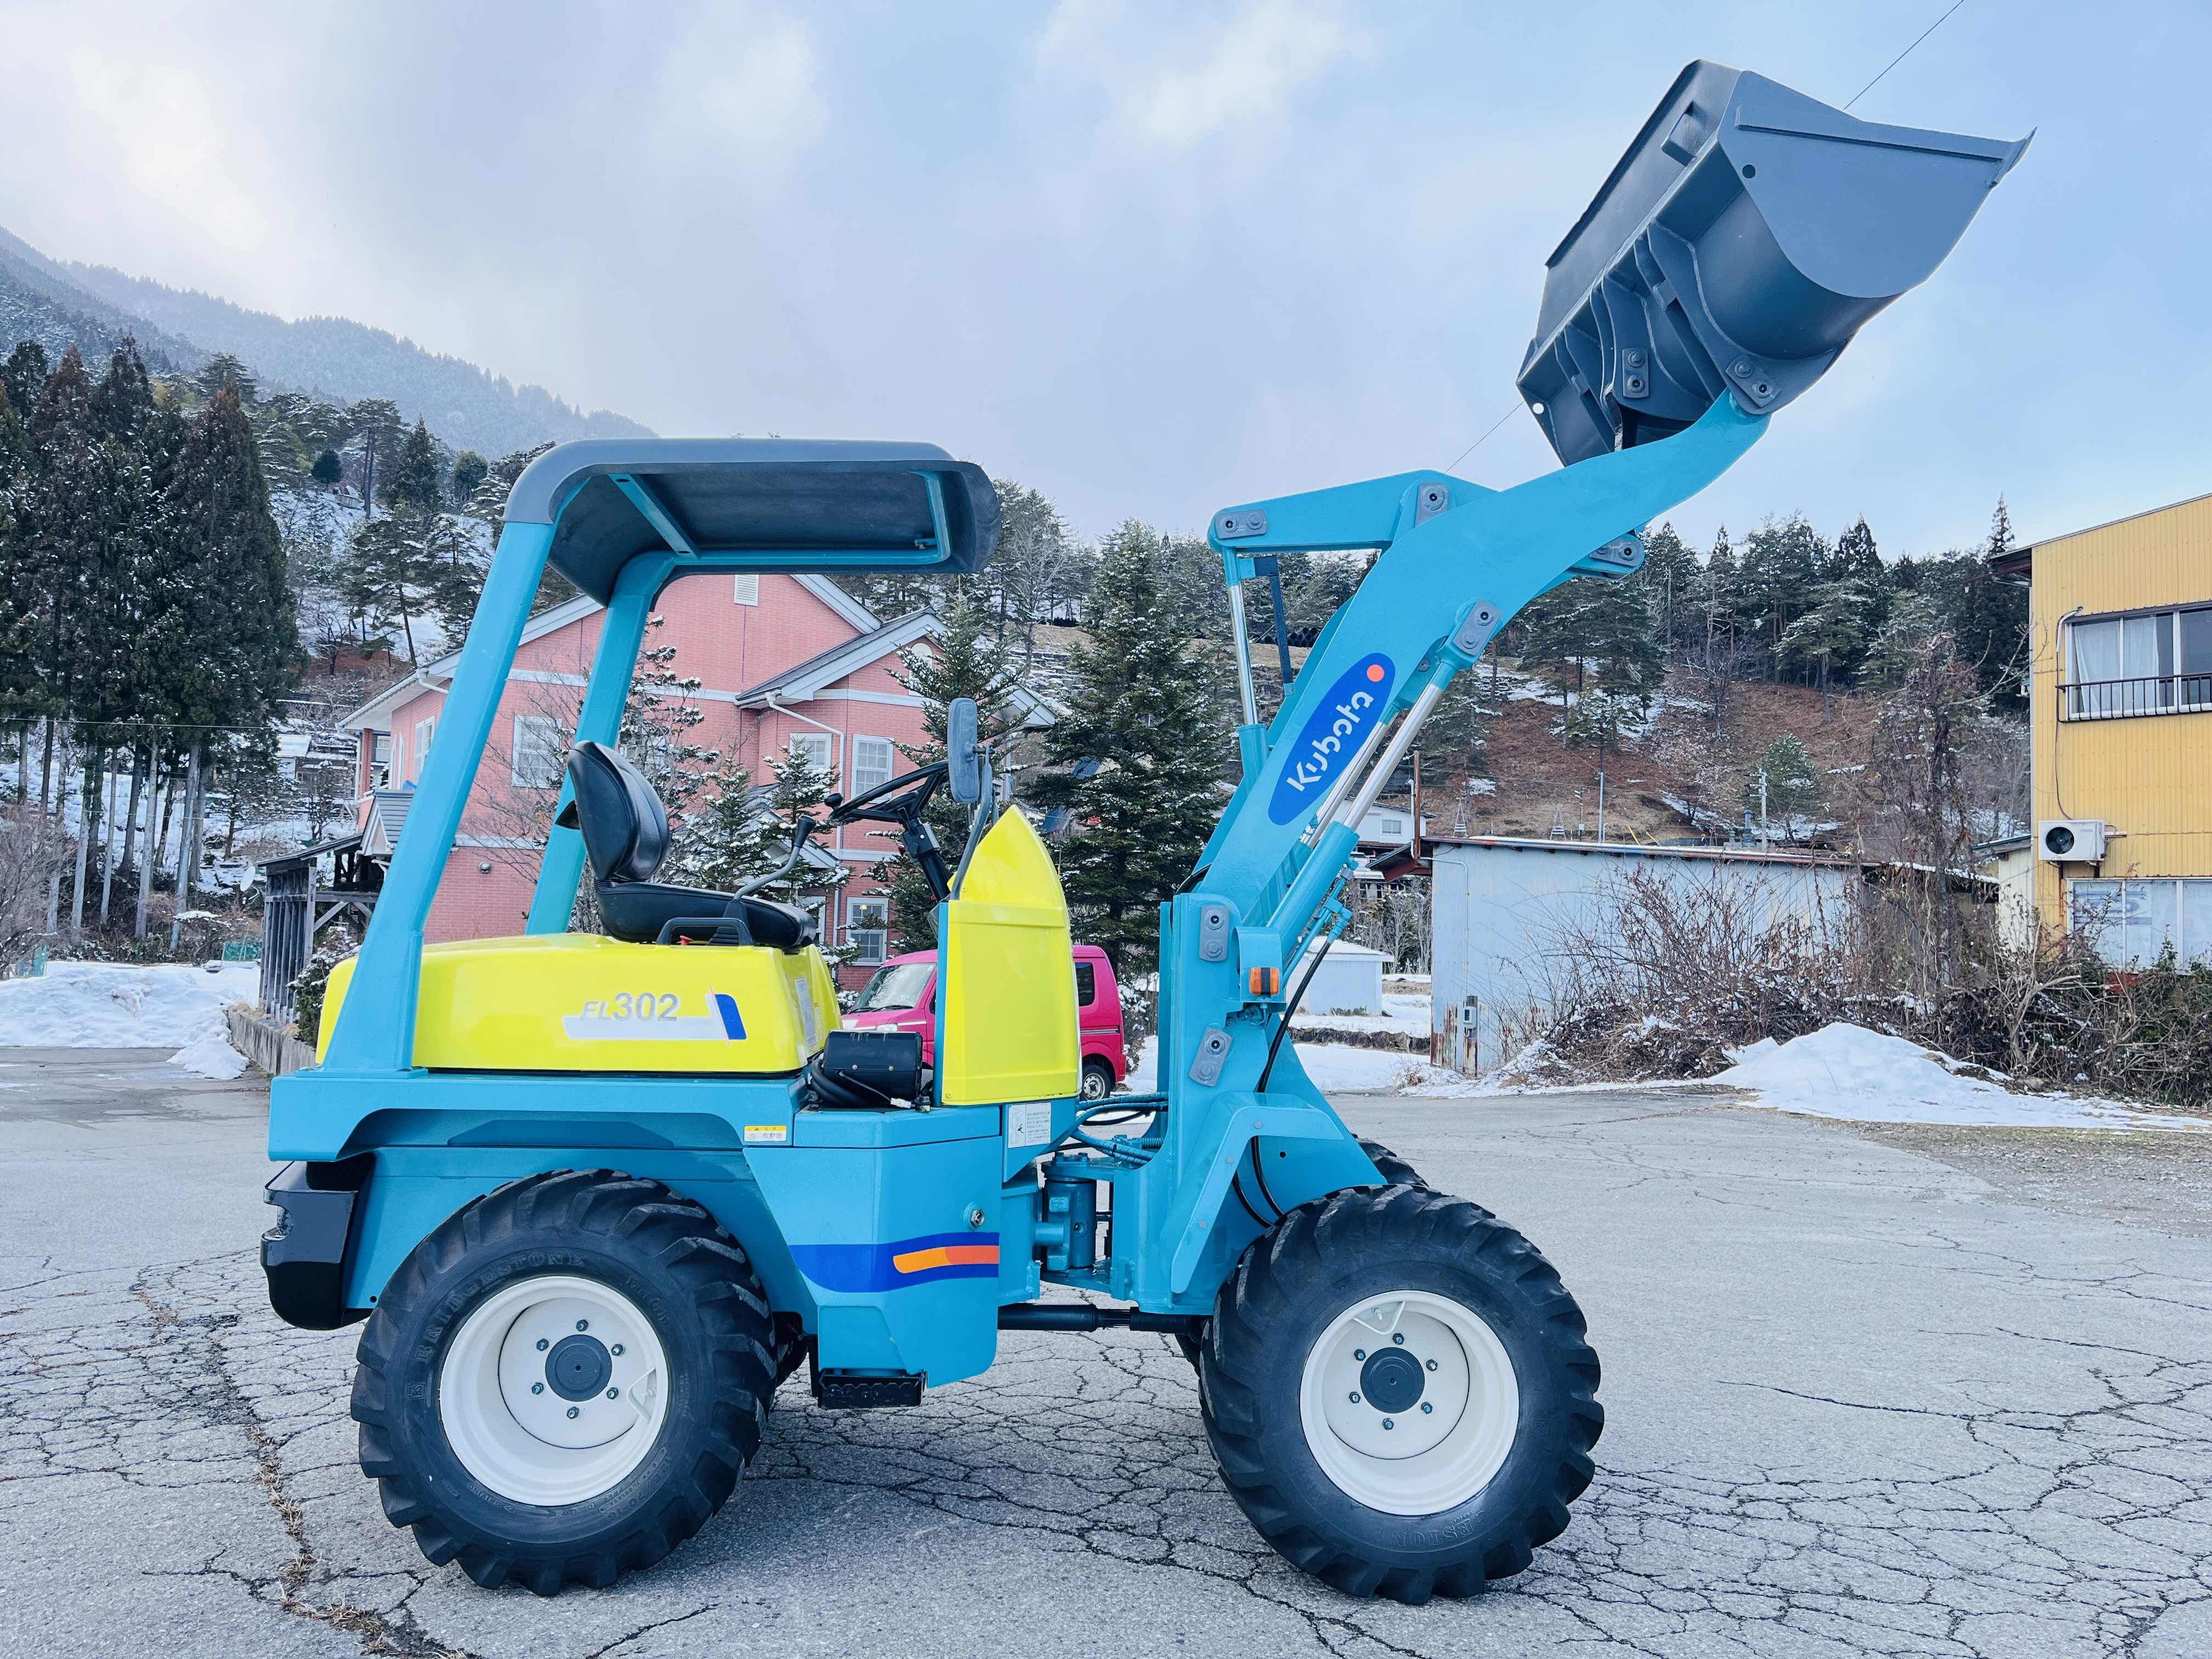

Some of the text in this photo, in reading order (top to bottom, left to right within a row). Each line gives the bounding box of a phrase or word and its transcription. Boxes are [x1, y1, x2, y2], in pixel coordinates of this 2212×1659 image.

[1286, 691, 1374, 792] Kubota
[580, 992, 679, 1022] FL302
[414, 1251, 585, 1364] BRIDGESTONE
[466, 1482, 503, 1508] DRIVING
